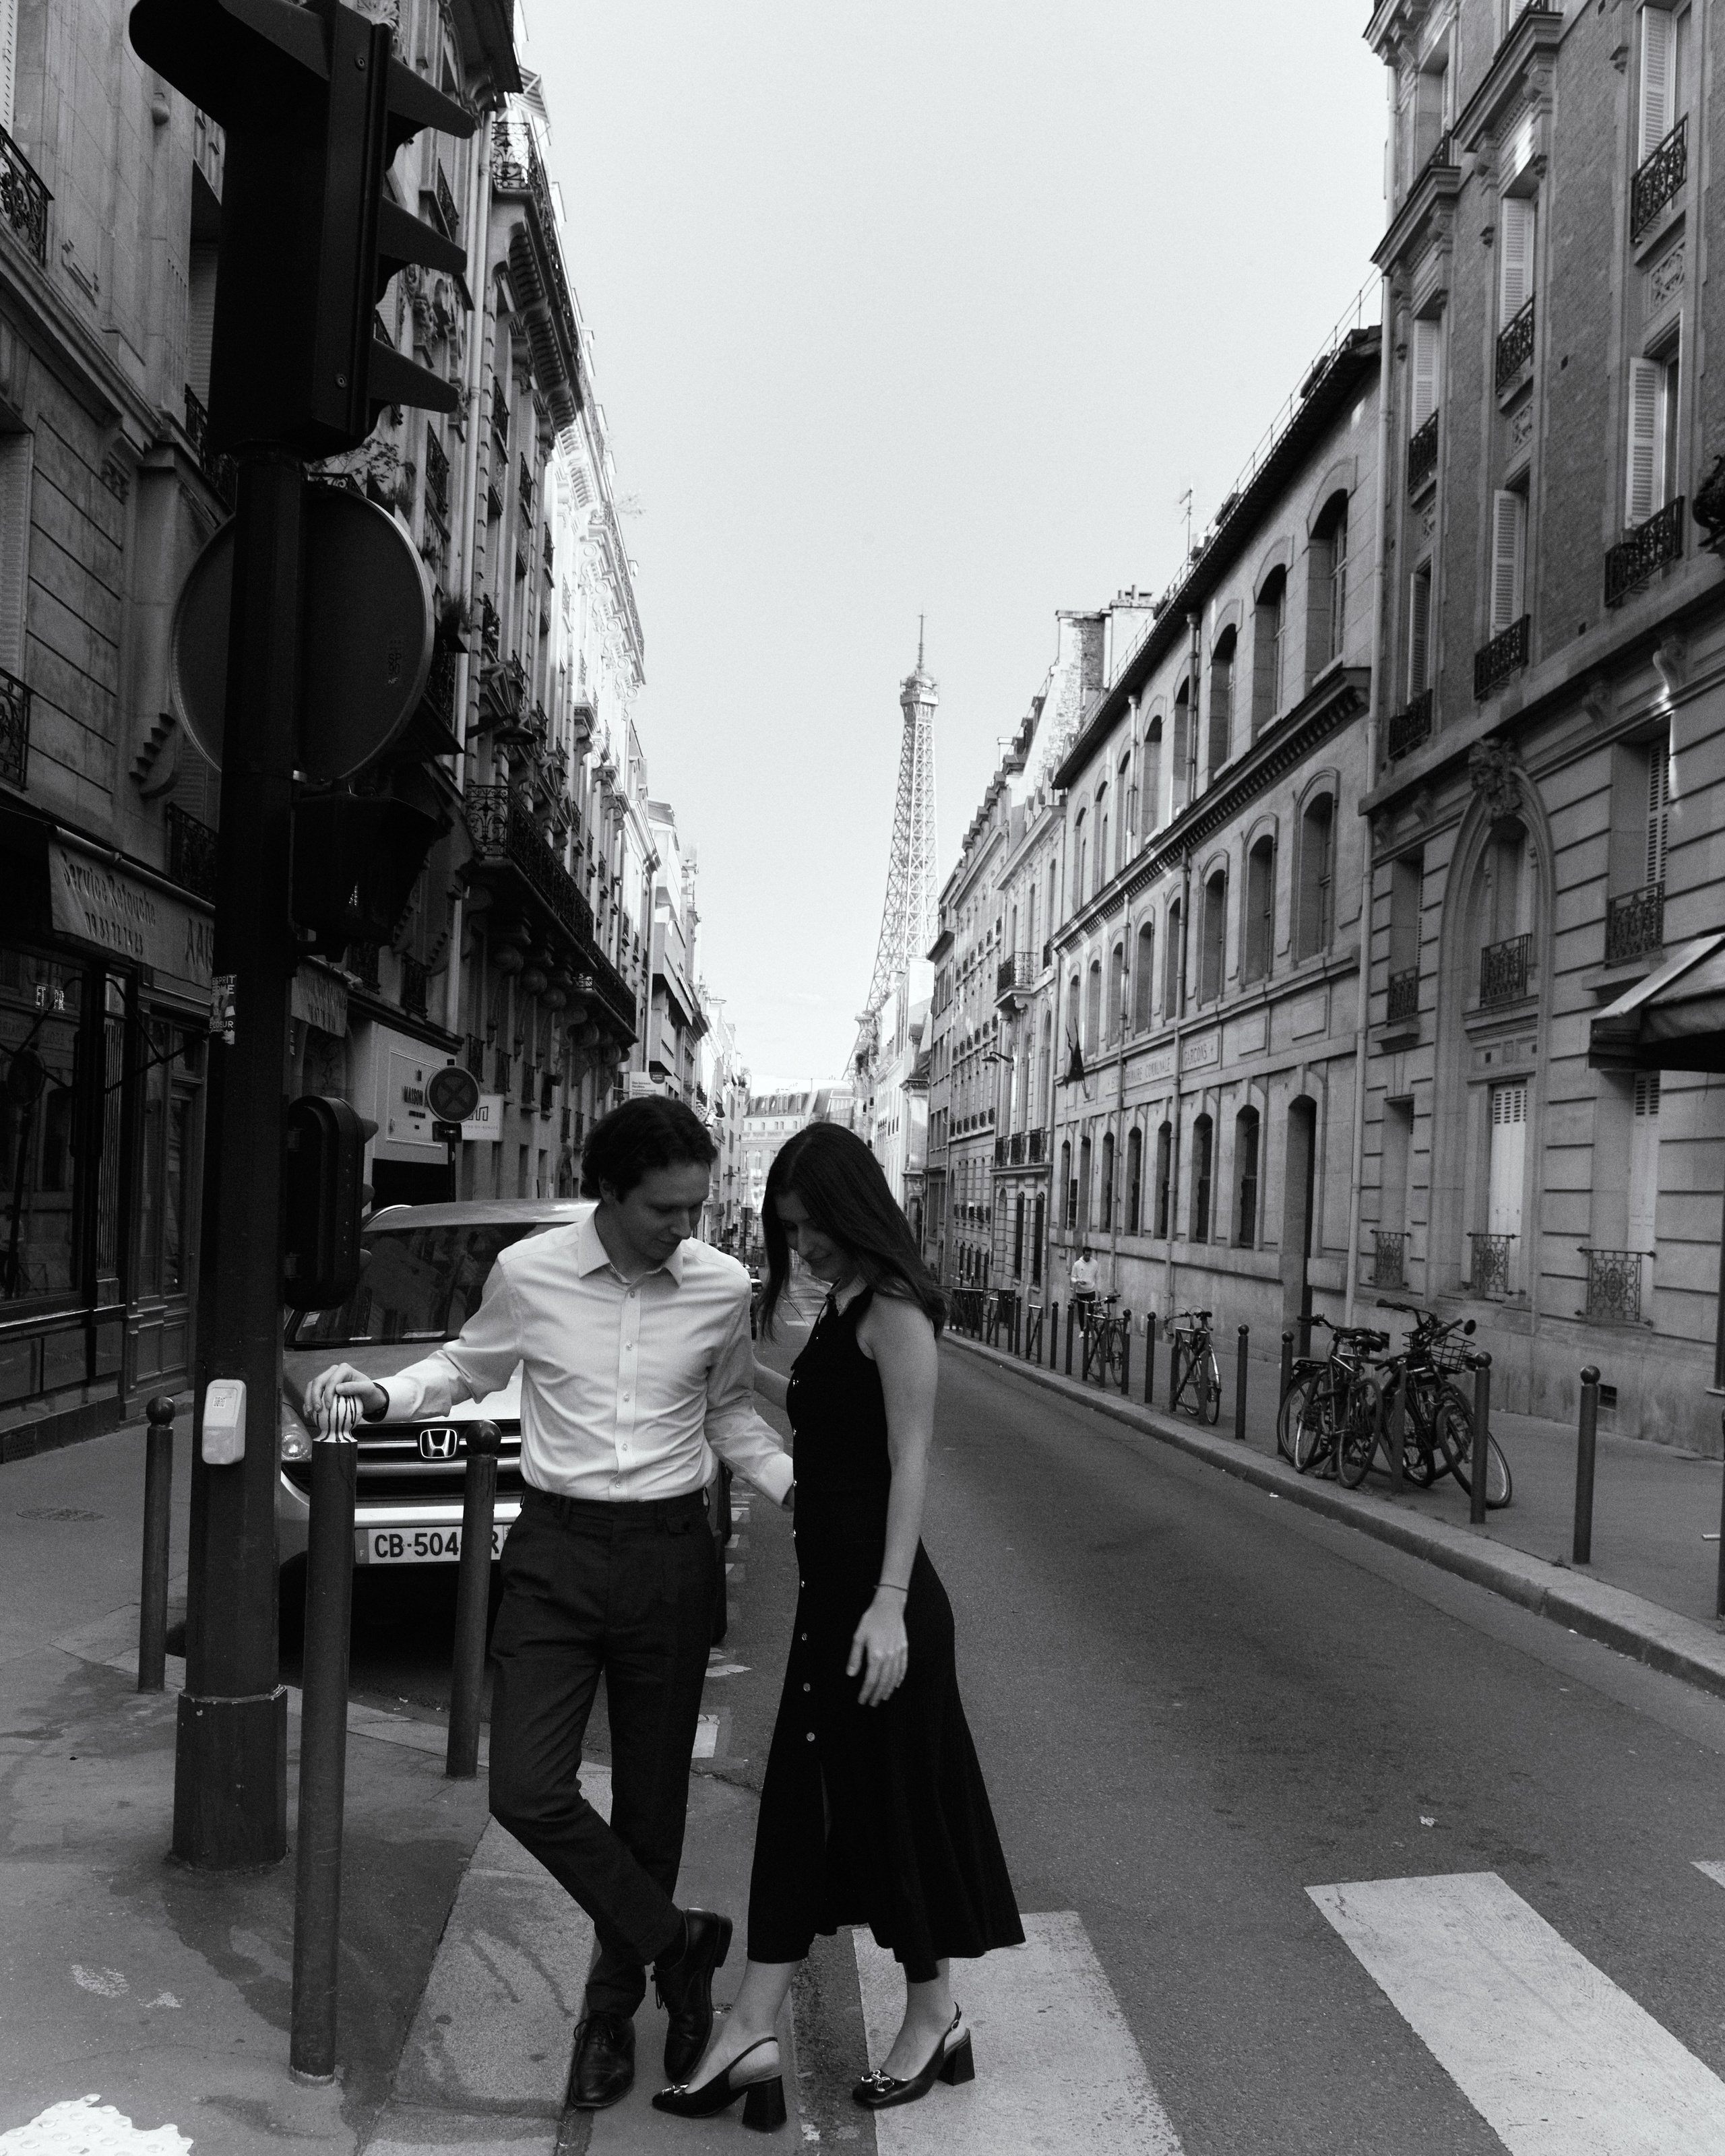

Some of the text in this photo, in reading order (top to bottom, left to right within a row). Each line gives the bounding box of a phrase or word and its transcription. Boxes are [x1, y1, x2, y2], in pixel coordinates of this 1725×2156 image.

[388, 653, 402, 664] SP
[388, 664, 401, 674] 90
[61, 850, 156, 925] Service Retouche
[404, 1086, 423, 1106] MAISON
